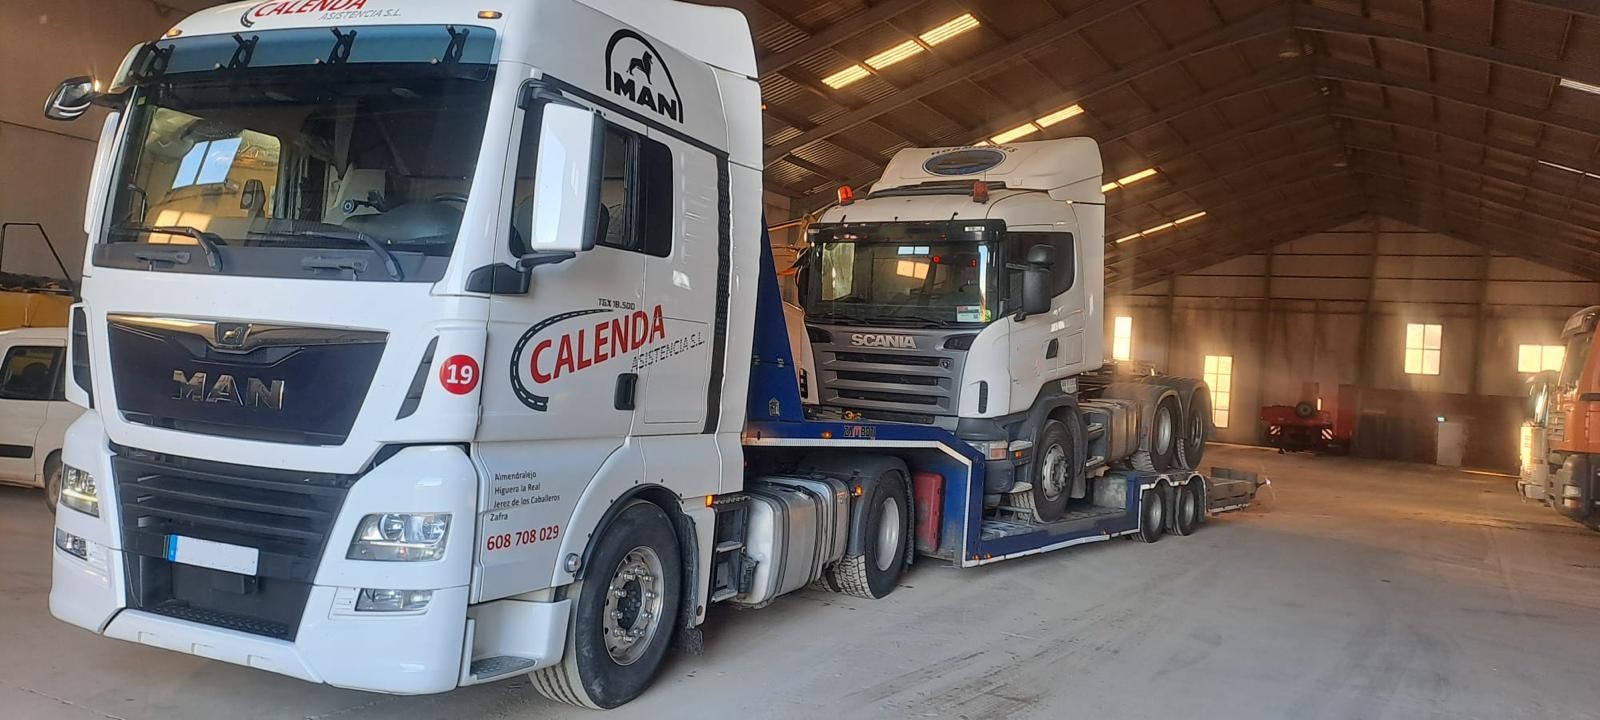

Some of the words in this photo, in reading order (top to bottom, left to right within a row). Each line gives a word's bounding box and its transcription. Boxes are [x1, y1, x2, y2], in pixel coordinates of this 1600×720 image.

[254, 0, 367, 17] CALENDA
[319, 9, 382, 20] ASISTENCIA
[613, 71, 677, 121] MAN
[598, 298, 611, 307] TGX
[530, 304, 665, 384] CALENDA
[851, 333, 916, 349] SCANIA
[631, 337, 689, 373] ASISTENCIA
[446, 364, 473, 384] 19
[171, 369, 284, 410] MAN
[494, 471, 537, 481] Almendralejo
[494, 486, 519, 496] Higuera
[520, 484, 527, 492] la
[528, 482, 541, 492] Real
[493, 500, 510, 509] Jerez
[511, 498, 519, 507] de
[520, 497, 530, 505] los
[530, 494, 560, 504] Caballeros
[490, 512, 508, 522] Zafra
[487, 533, 511, 551] 608
[515, 529, 537, 546] 708
[539, 525, 559, 542] 029
